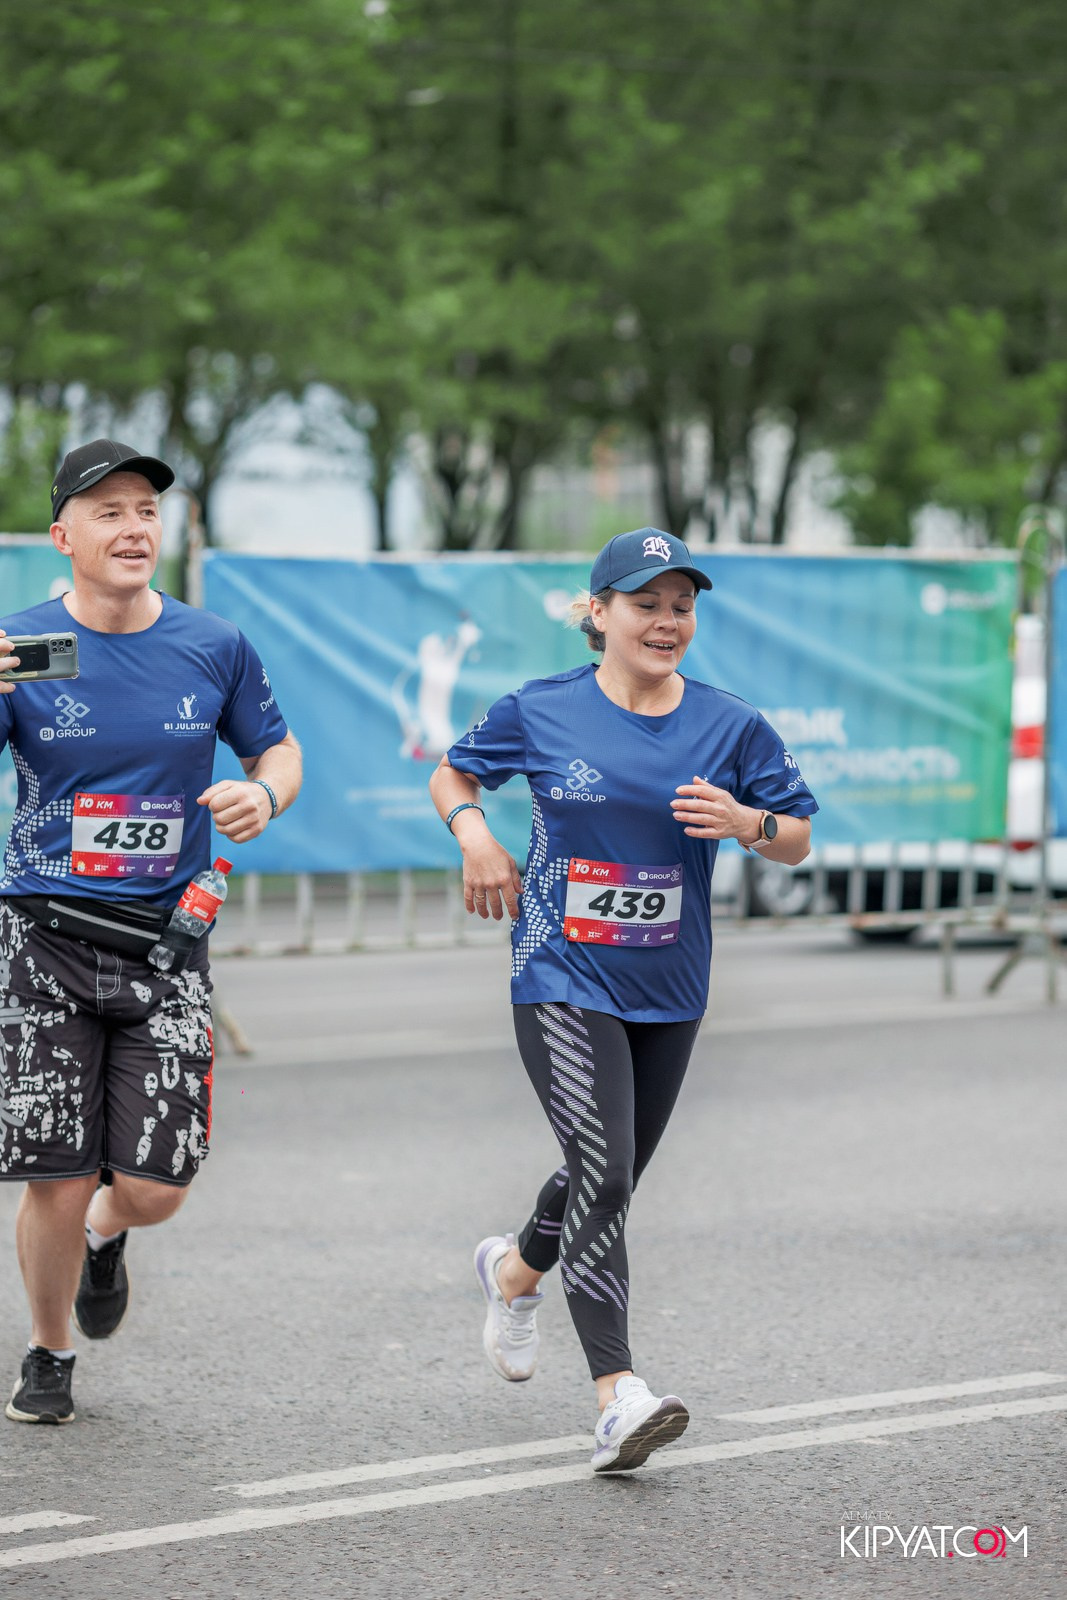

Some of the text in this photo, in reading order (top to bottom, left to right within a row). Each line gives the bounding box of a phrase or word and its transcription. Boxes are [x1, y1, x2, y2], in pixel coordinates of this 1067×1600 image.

[164, 722, 173, 730] BI
[41, 727, 97, 740] BI GROUP
[552, 787, 607, 803] BI GROUP
[79, 797, 114, 810] 10 KM
[93, 821, 169, 851] 438
[575, 864, 610, 877] 10 KM
[588, 889, 666, 921] 439
